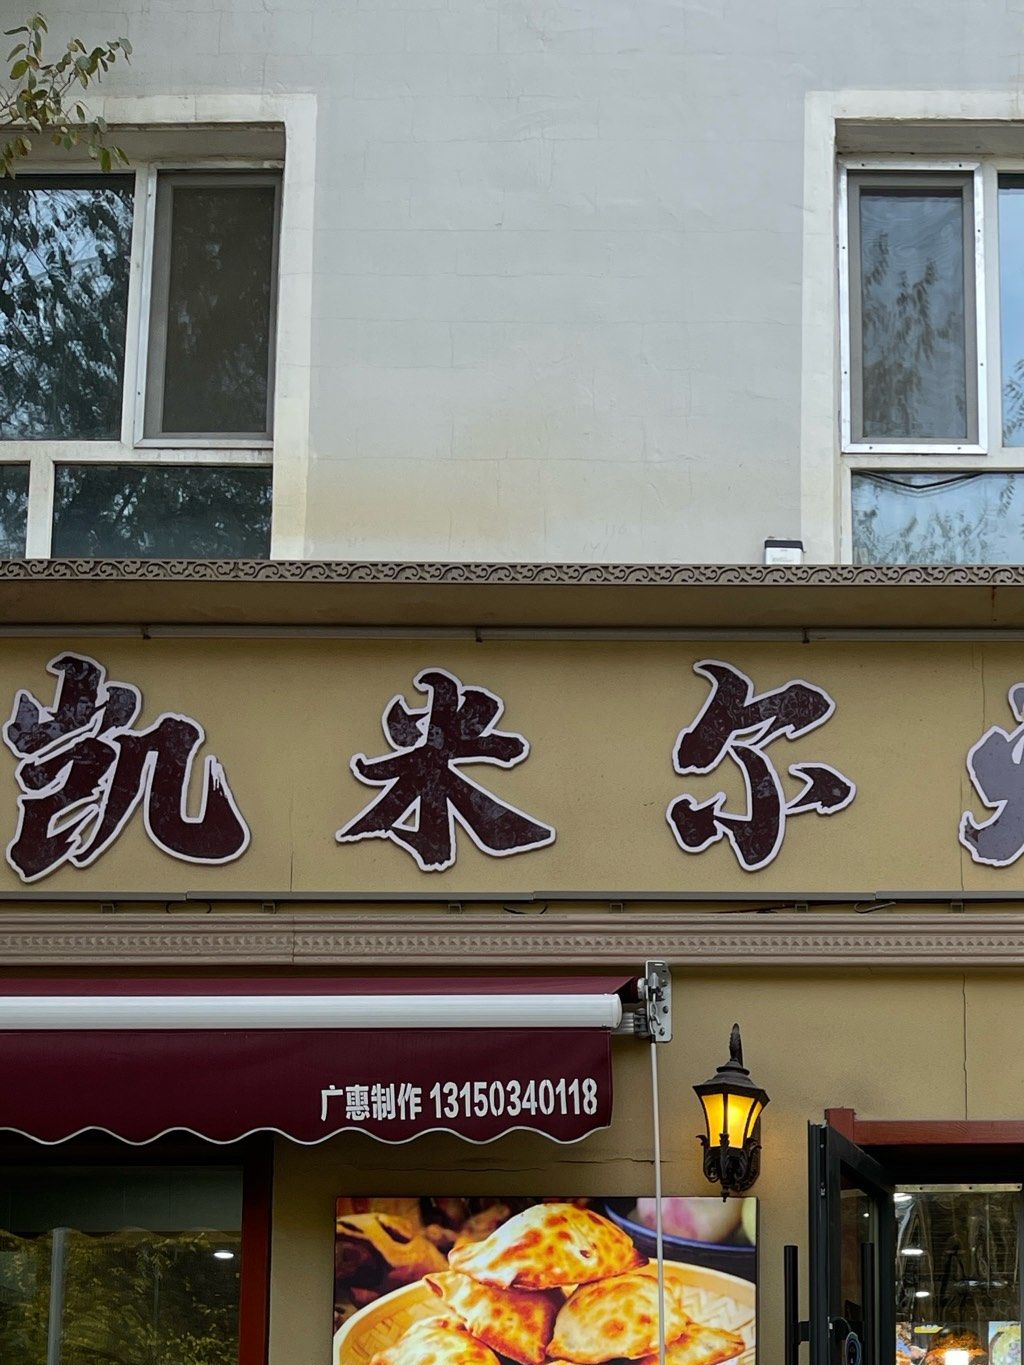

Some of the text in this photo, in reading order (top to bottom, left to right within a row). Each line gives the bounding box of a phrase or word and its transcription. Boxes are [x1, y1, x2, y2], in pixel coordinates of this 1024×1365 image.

[320, 1078, 598, 1121] 广惠制作 13150340118
